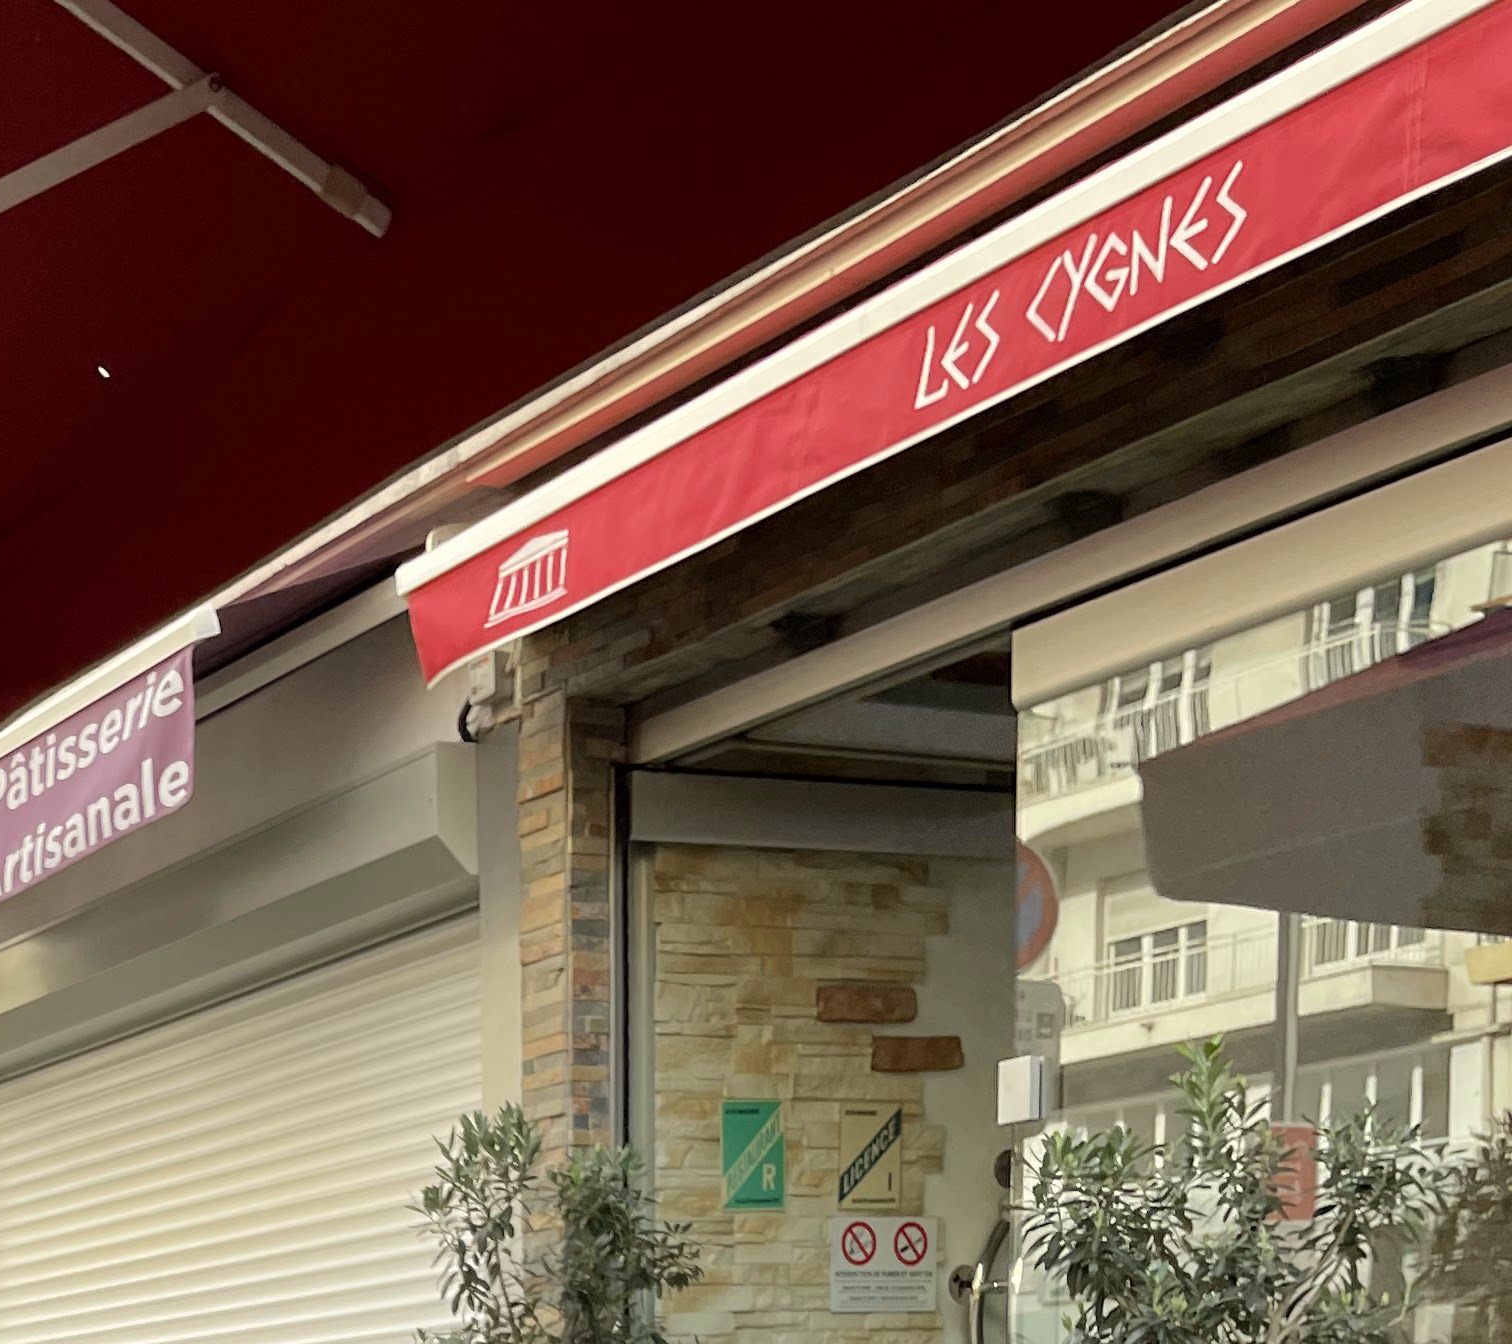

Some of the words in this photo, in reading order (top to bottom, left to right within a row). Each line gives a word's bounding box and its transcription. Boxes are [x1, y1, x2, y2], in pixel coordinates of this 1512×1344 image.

[915, 290, 1000, 409] LES
[1026, 161, 1247, 341] CYGNES
[761, 1163, 776, 1191] R
[842, 1115, 897, 1196] LICENCE
